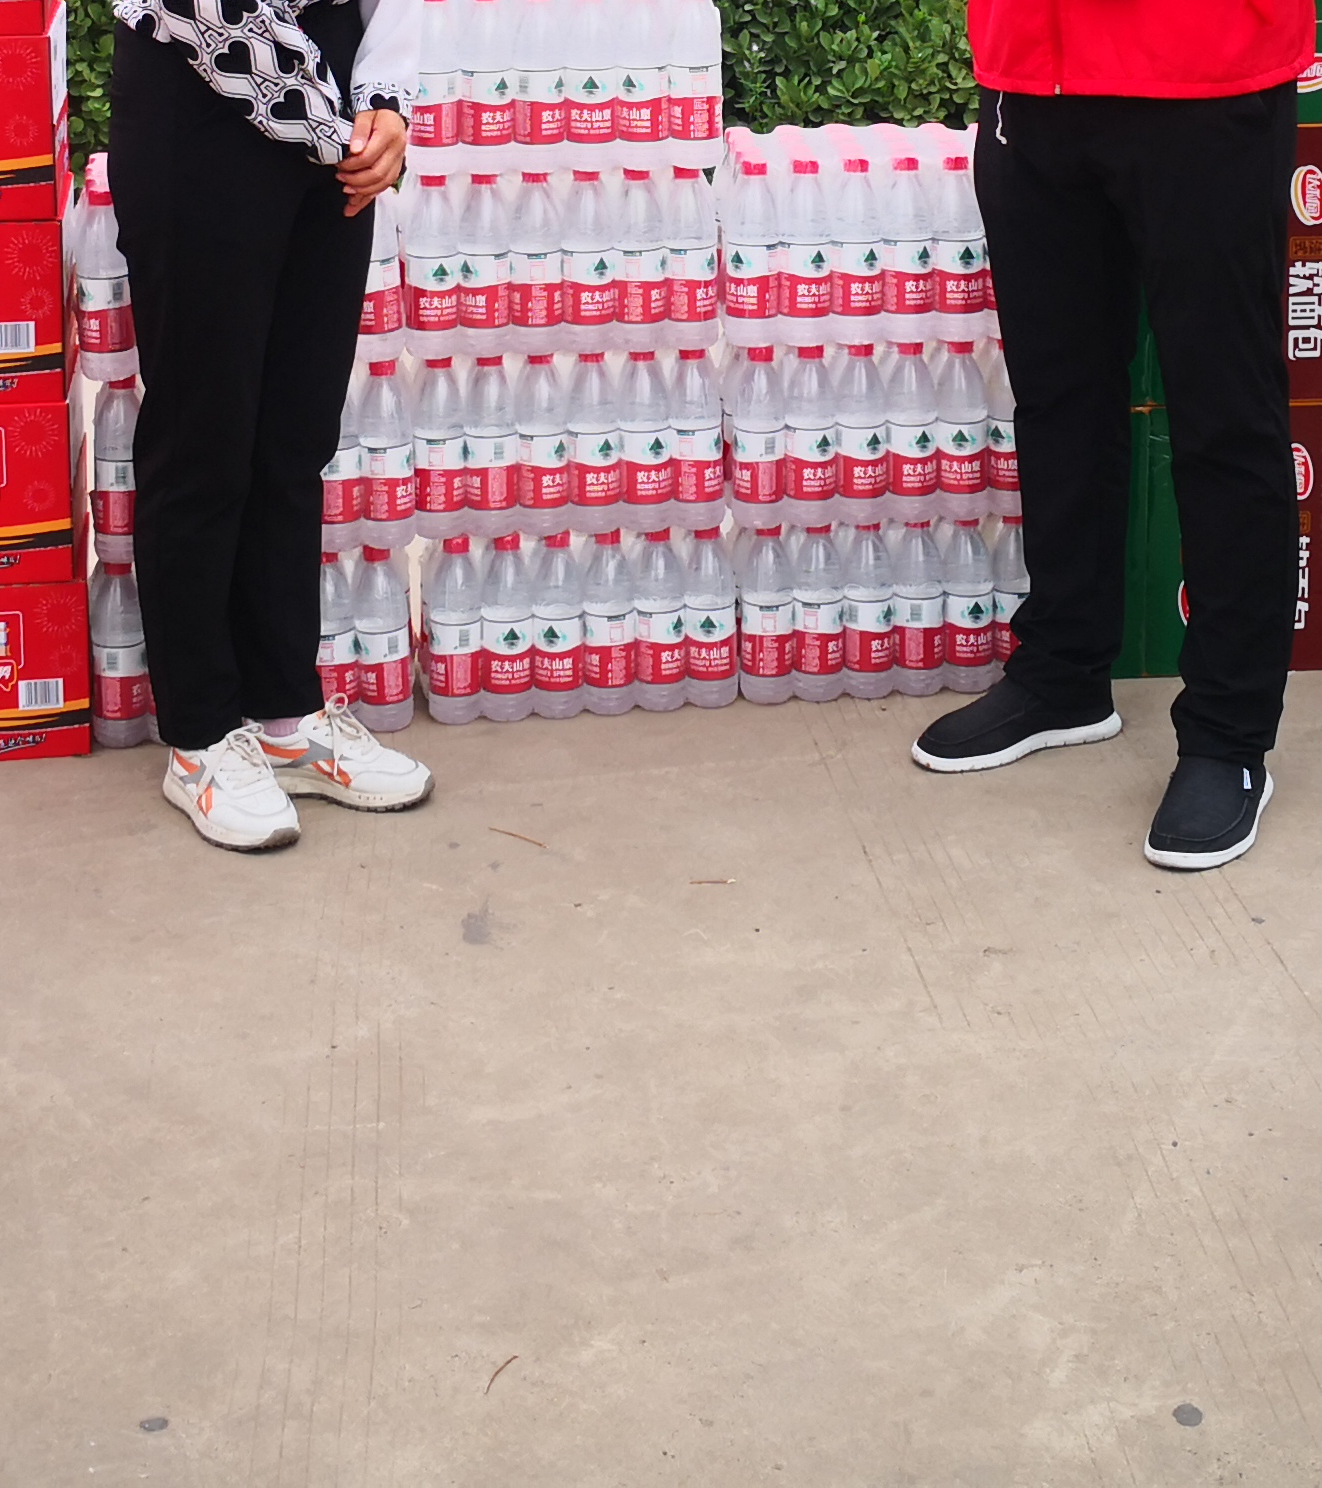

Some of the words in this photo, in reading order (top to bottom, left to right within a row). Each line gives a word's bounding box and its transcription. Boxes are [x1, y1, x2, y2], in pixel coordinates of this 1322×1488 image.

[571, 108, 613, 121] 农夫山泉
[941, 459, 981, 472] 农夫山泉
[689, 646, 729, 660] 农夫山泉
